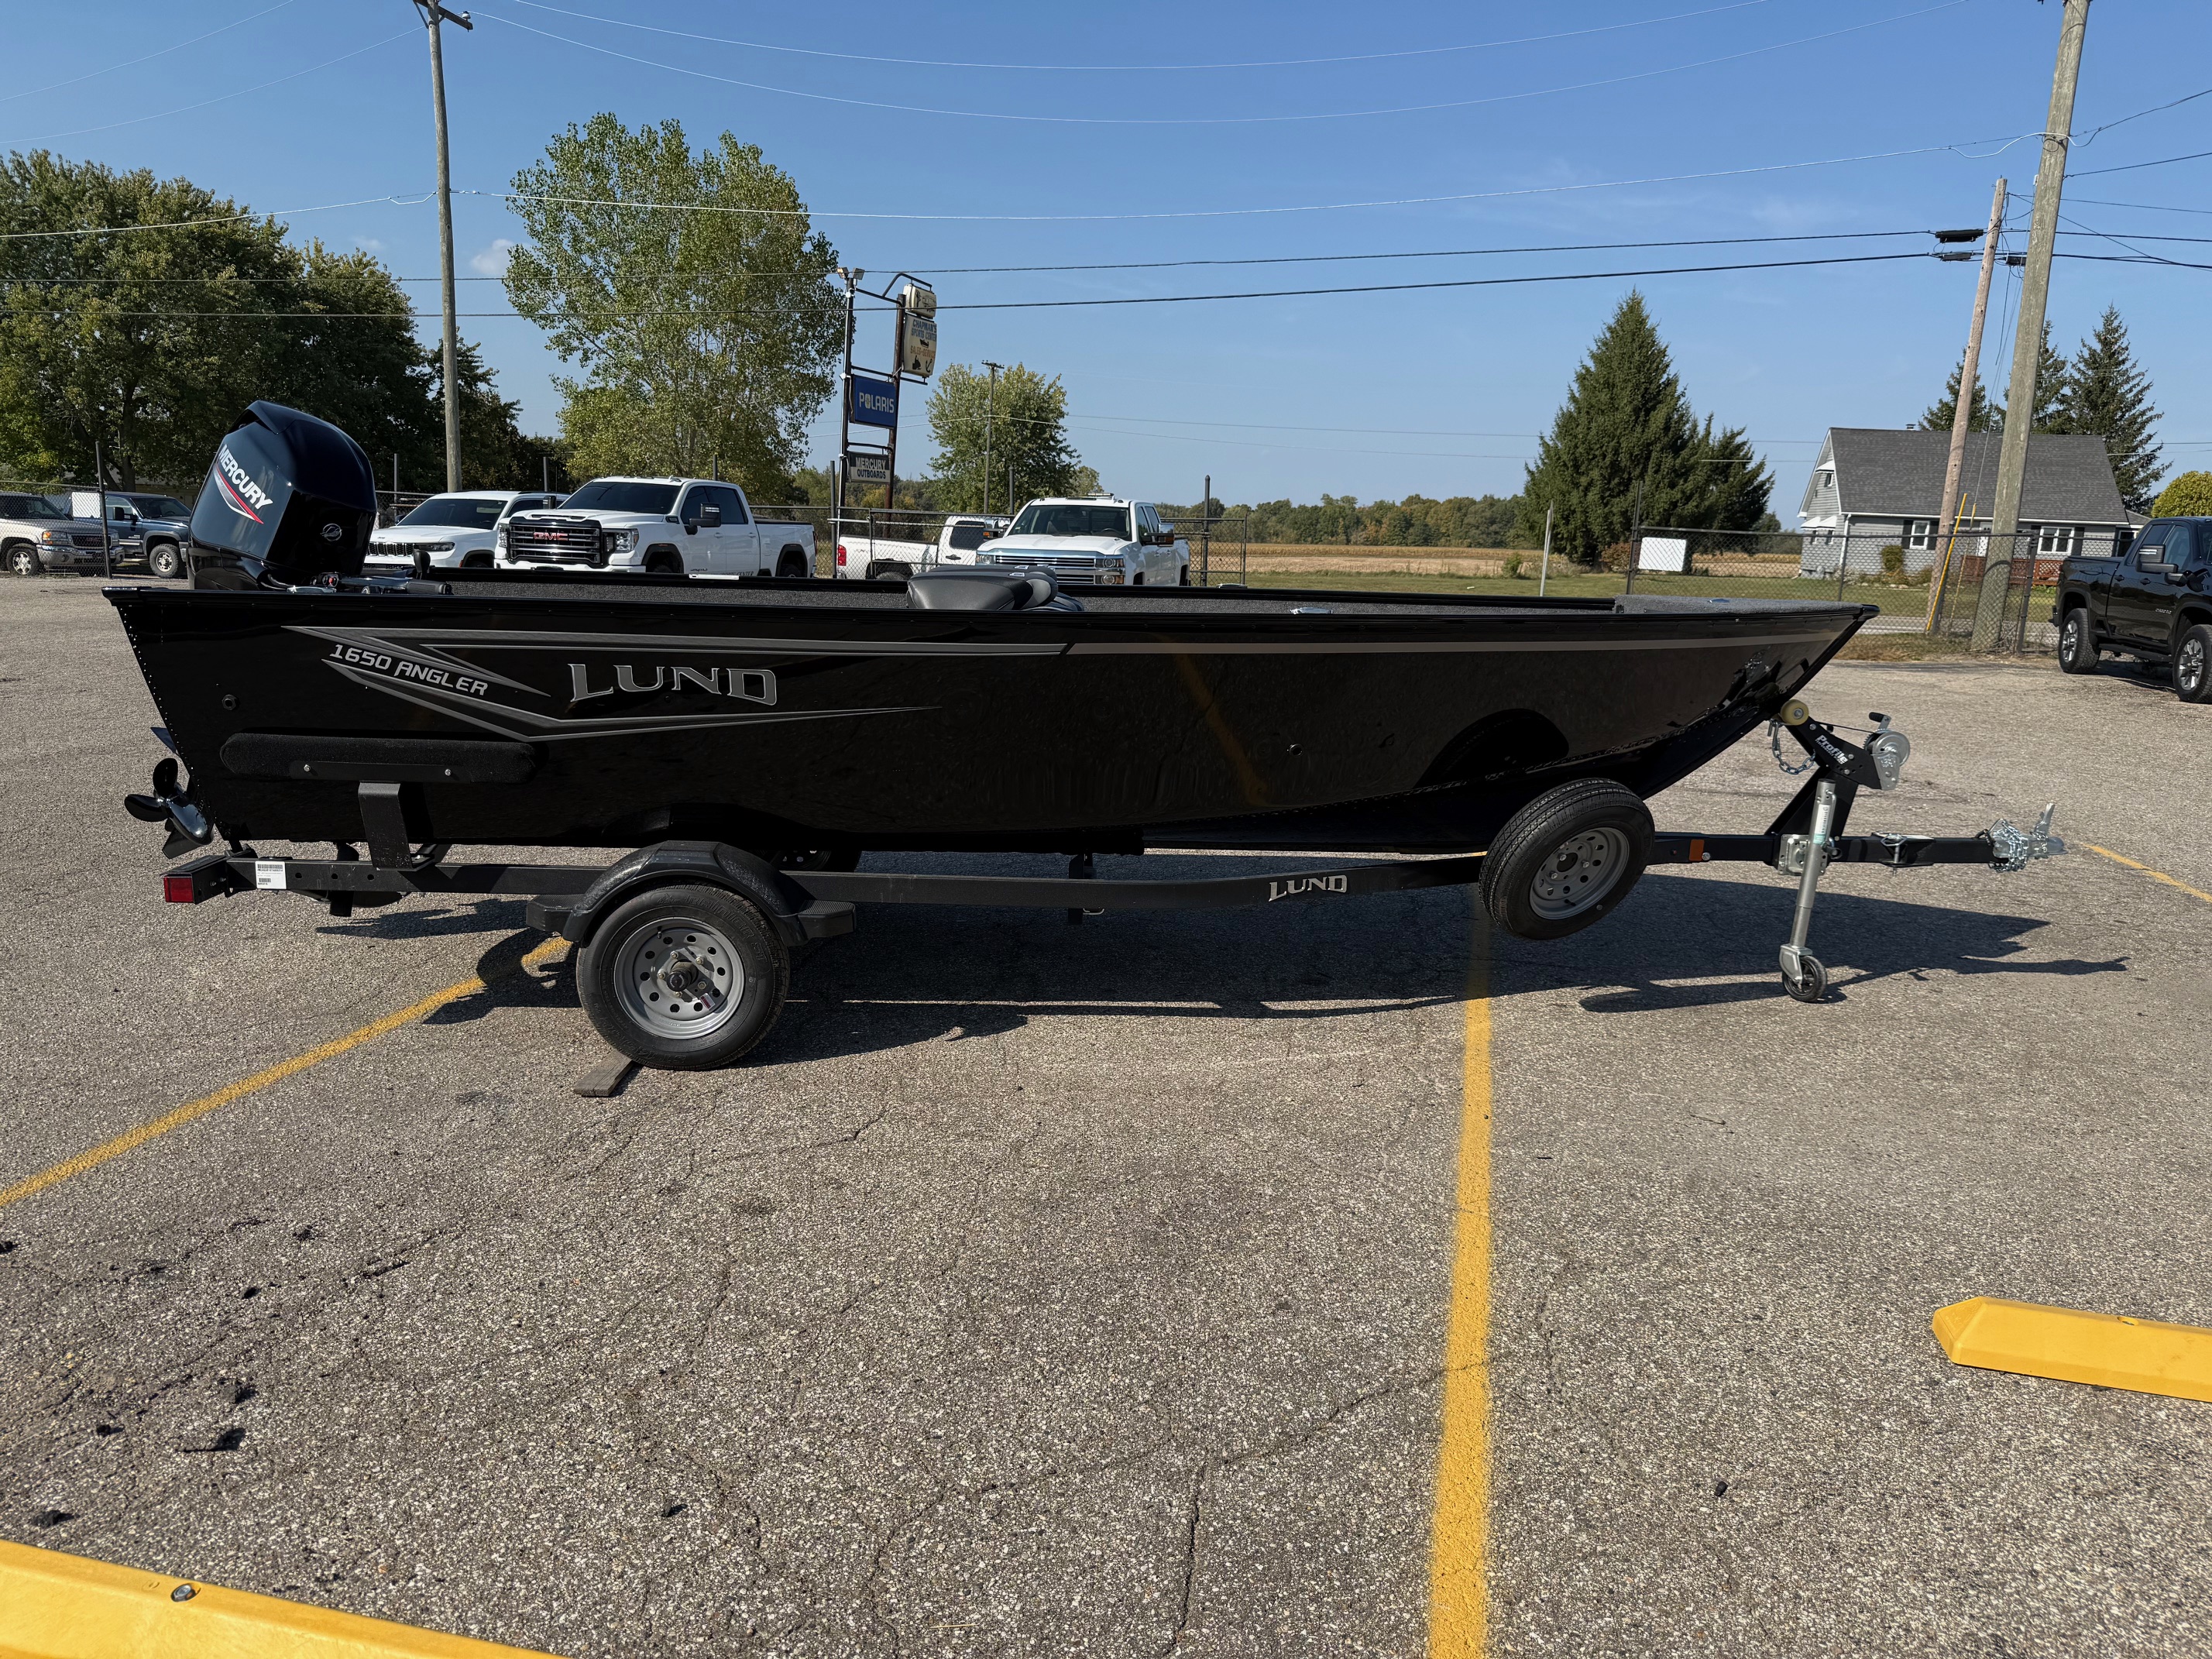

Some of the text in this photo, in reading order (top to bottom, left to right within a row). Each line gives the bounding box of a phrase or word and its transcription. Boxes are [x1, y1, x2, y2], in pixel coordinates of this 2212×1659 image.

[911, 328, 925, 339] SPORTS
[859, 392, 895, 414] POLARIS
[855, 457, 887, 471] MERCURY
[857, 469, 887, 479] OUTBOARDS
[218, 444, 273, 510] MERCURY
[534, 531, 568, 541] GMC
[329, 644, 489, 696] 1650 ANGLER
[567, 663, 778, 706] LUND
[1815, 734, 1849, 762] Profile
[1268, 874, 1348, 902] LUND
